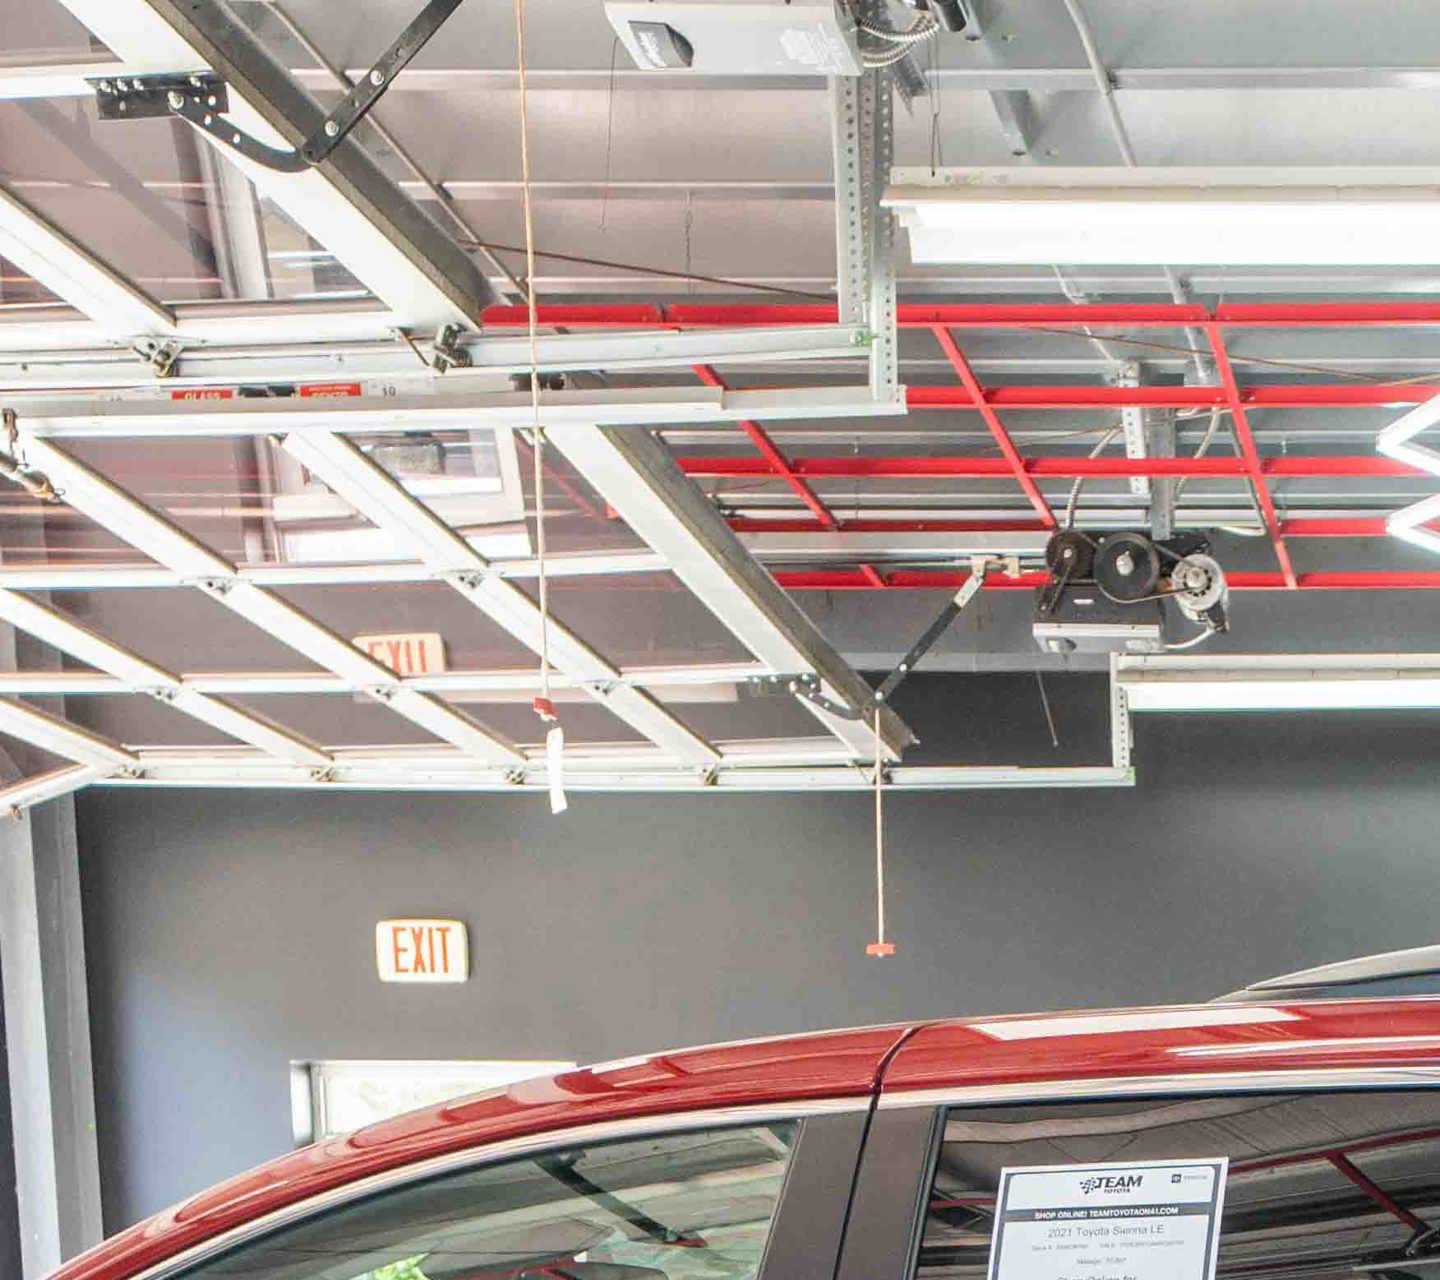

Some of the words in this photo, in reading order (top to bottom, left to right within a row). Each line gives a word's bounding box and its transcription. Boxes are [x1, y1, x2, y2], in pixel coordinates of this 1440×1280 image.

[393, 925, 451, 975] EXIT
[1095, 1175, 1143, 1188] TEAM
[1034, 1211, 1055, 1219] SHOP
[1047, 1228, 1071, 1238] 2021
[1076, 1226, 1109, 1240] Toyota
[1150, 1223, 1164, 1233] LE
